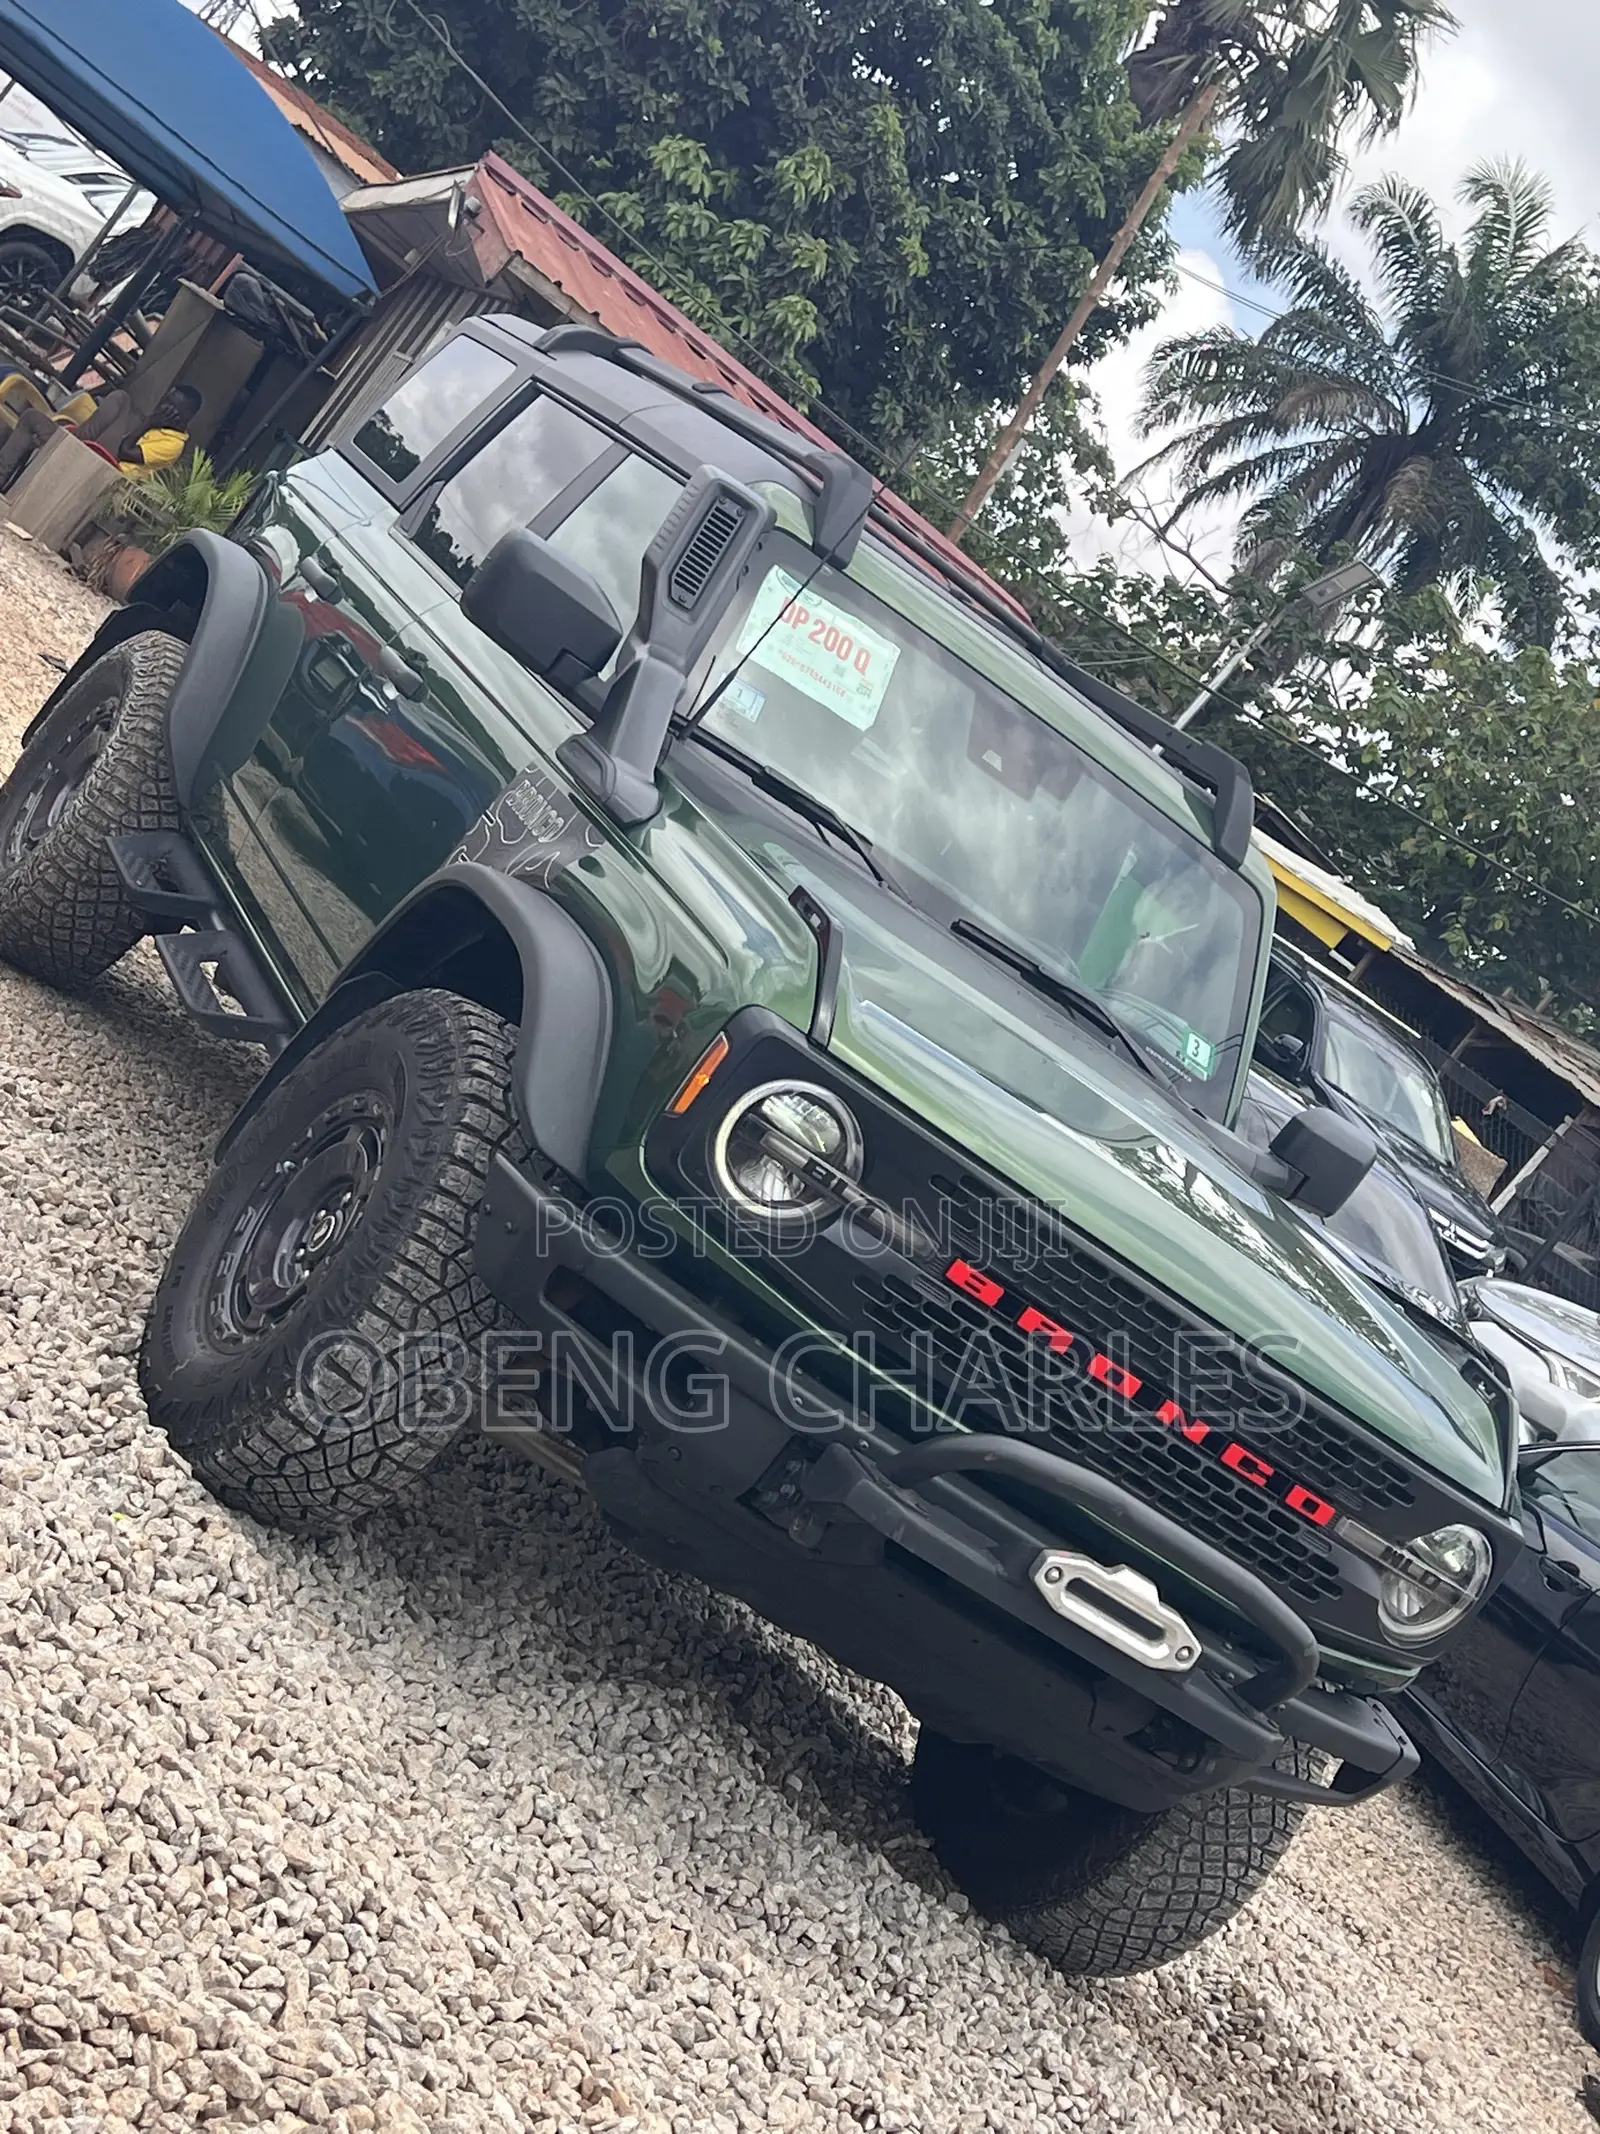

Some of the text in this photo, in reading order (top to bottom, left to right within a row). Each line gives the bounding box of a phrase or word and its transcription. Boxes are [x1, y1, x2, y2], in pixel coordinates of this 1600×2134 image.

[779, 597, 810, 630] DP
[808, 618, 854, 662] 200
[854, 647, 872, 676] Q
[505, 779, 565, 843] BRONCO
[1192, 1039, 1201, 1058] 3
[946, 1258, 1336, 1527] BRONCO
